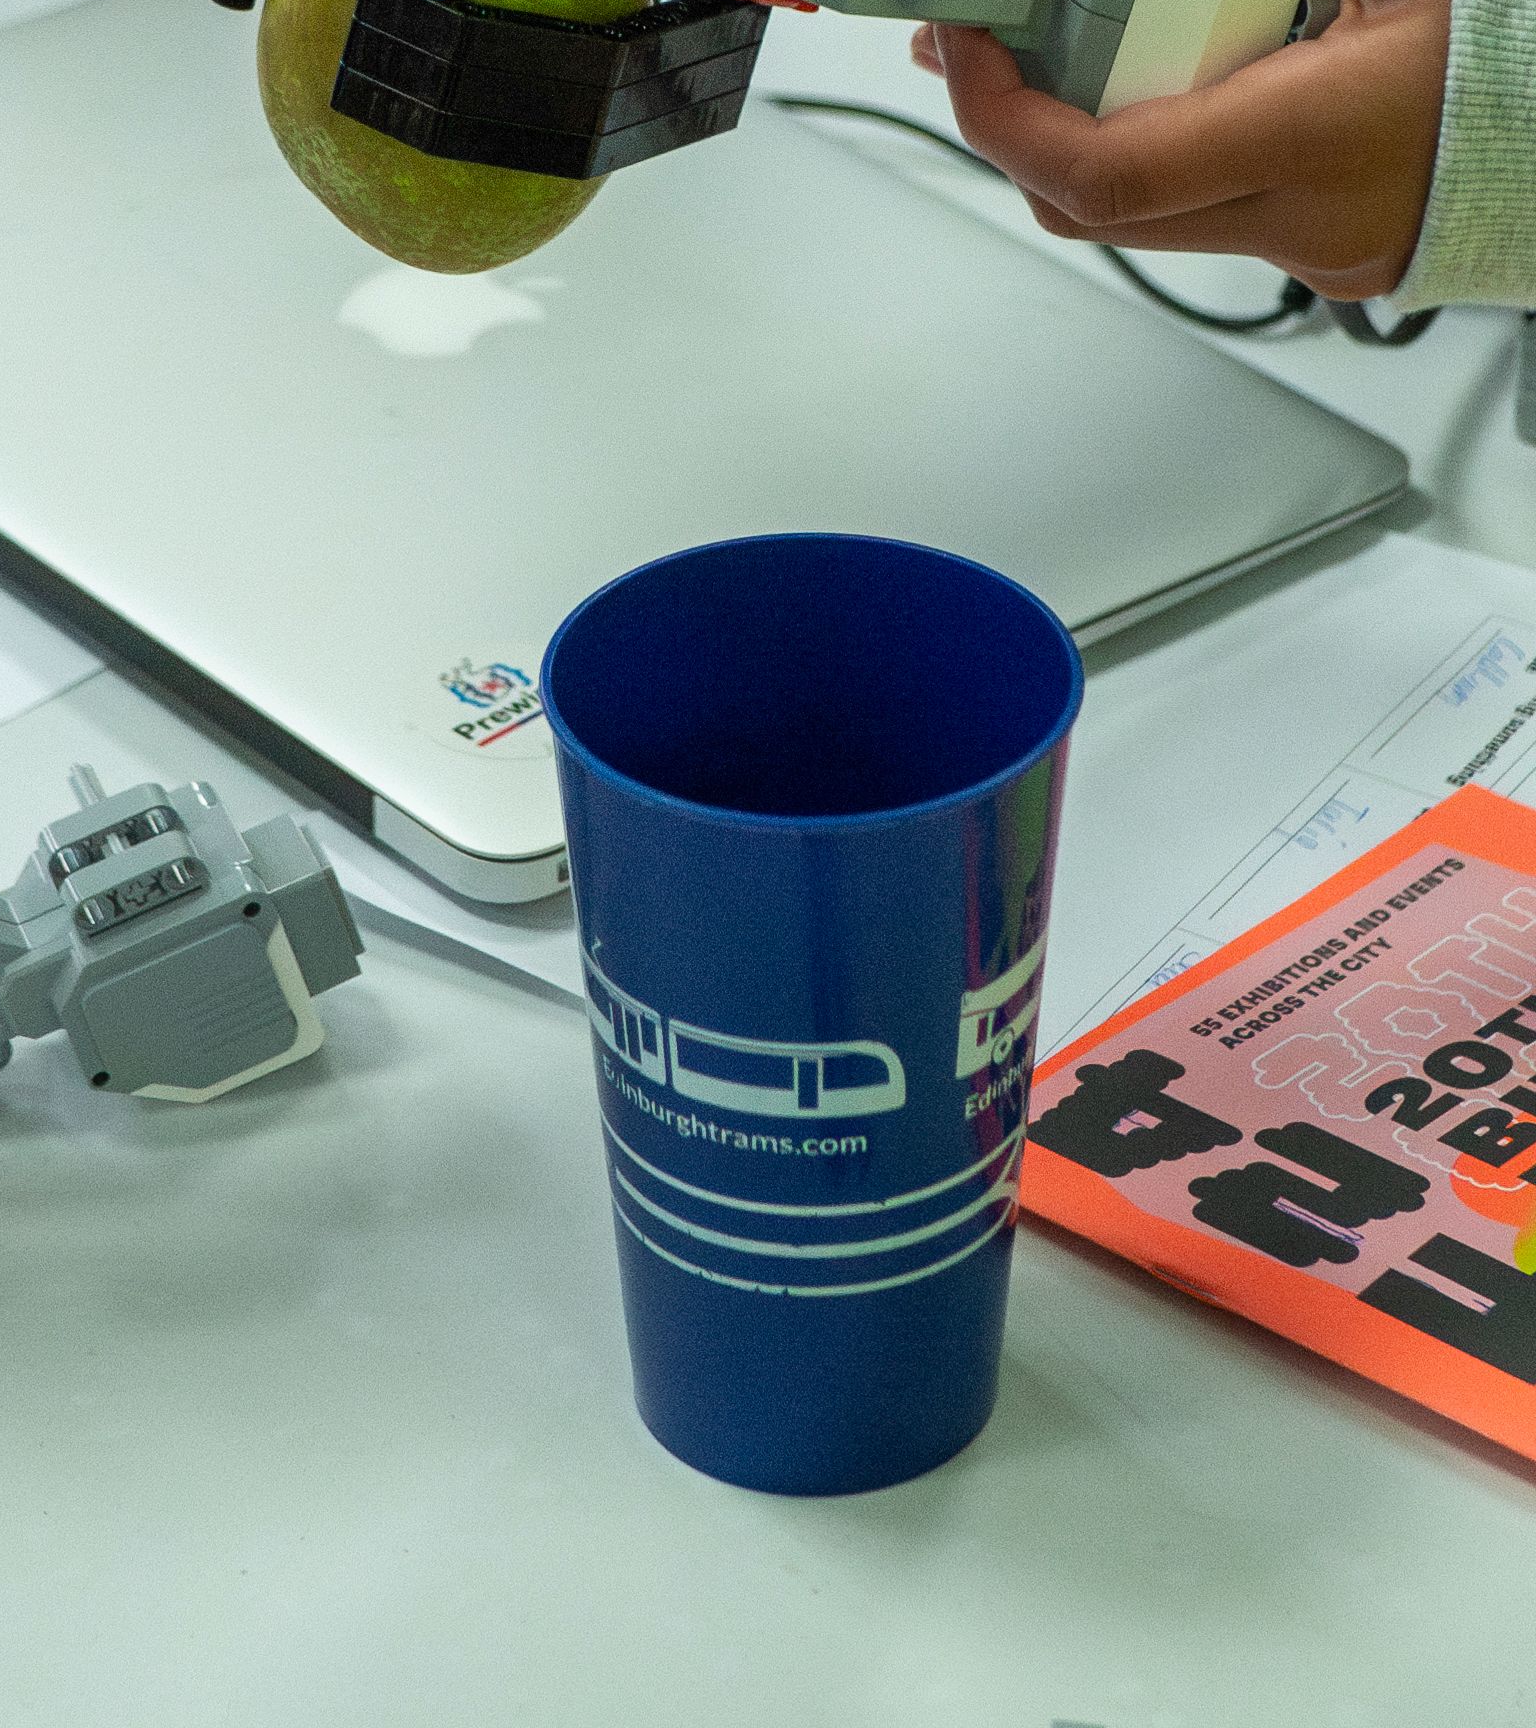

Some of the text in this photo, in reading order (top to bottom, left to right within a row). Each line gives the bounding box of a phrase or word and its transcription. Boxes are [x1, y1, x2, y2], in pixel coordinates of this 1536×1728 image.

[1189, 1017, 1224, 1038] 55
[1216, 937, 1348, 1021] EXHIBITIONS
[1343, 908, 1393, 942] AND
[1386, 857, 1466, 912] EVENTS
[1218, 936, 1393, 1050] ACROSS THE CITY
